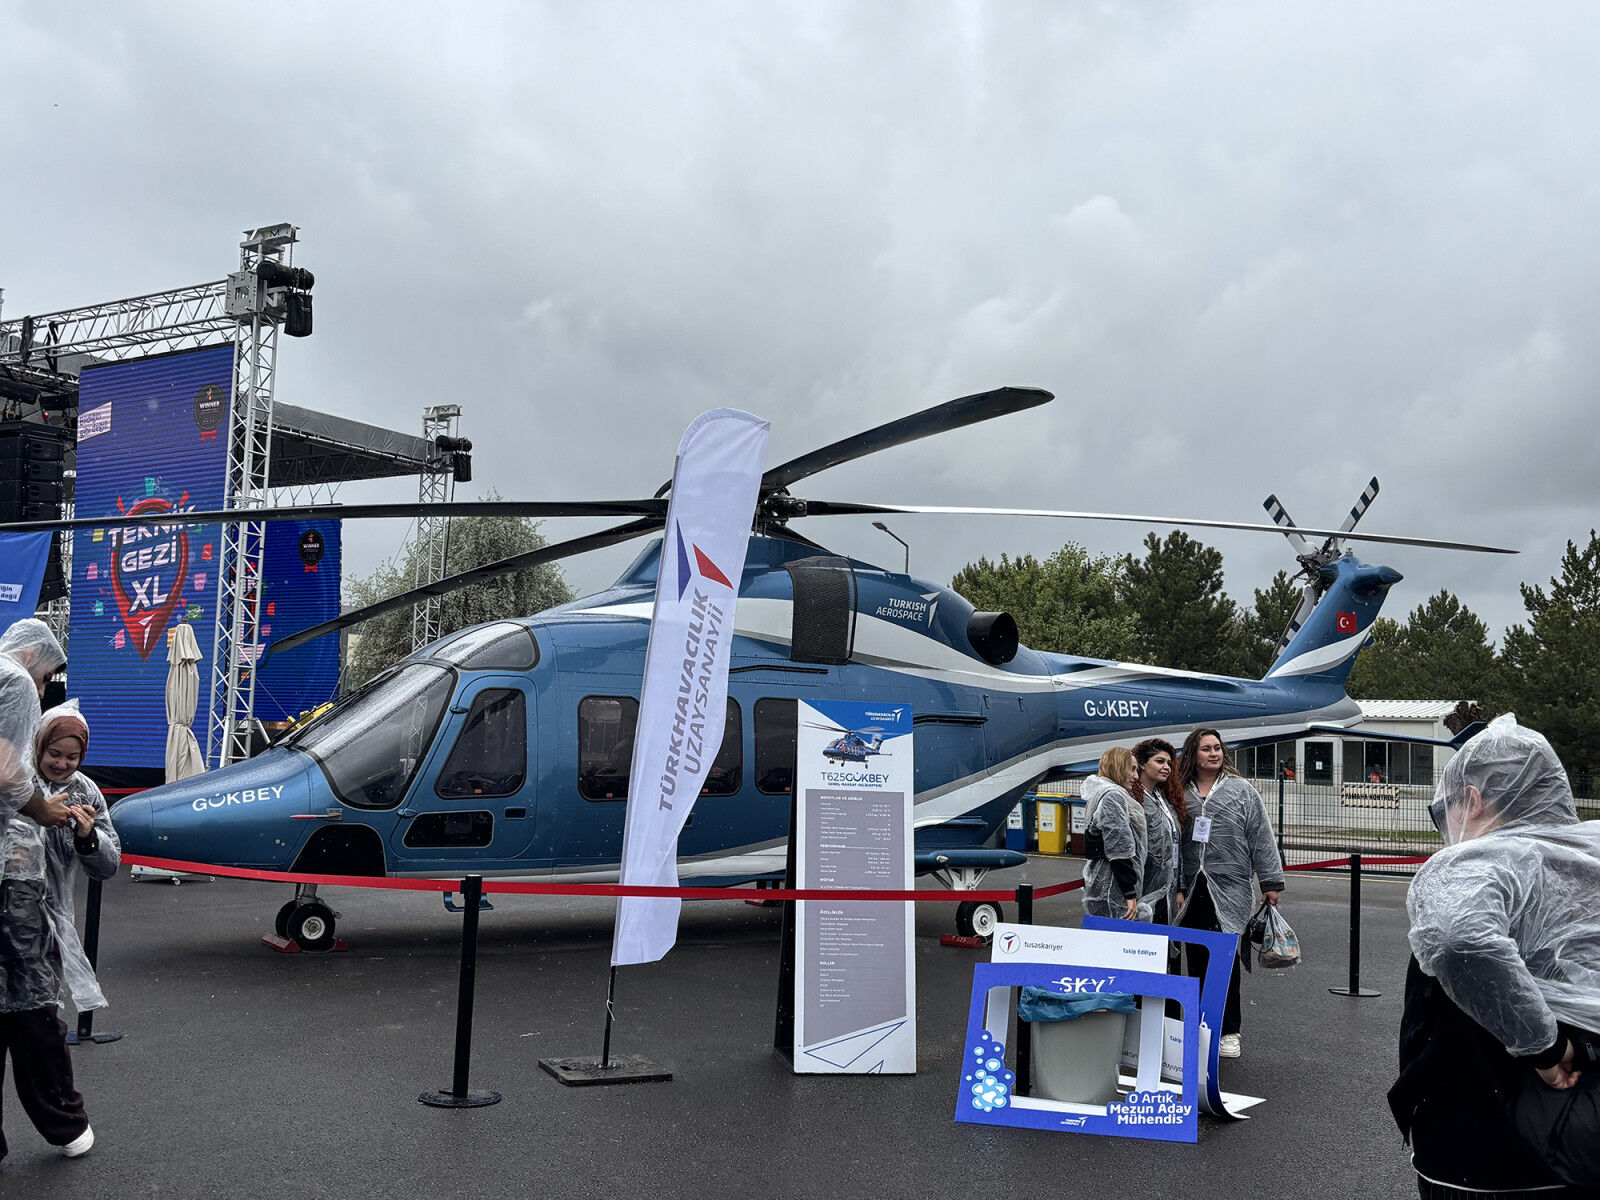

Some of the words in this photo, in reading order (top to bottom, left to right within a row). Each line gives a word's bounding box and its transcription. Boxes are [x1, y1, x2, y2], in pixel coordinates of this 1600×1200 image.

[199, 401, 220, 409] WINNER
[121, 535, 177, 573] GEZİ
[129, 575, 169, 613] XL
[888, 598, 927, 612] TURKISH
[876, 606, 924, 622] AEROSPACE
[659, 587, 709, 812] TÜRKHAVACILIK
[1024, 941, 1063, 951] tusaskariyer
[1058, 976, 1106, 993] SKY
[1128, 1093, 1138, 1103] O
[1142, 1093, 1174, 1103] Artık
[1110, 1104, 1154, 1114] Mezun
[1157, 1104, 1193, 1116] Aday
[1117, 1114, 1184, 1125] Mühendis
